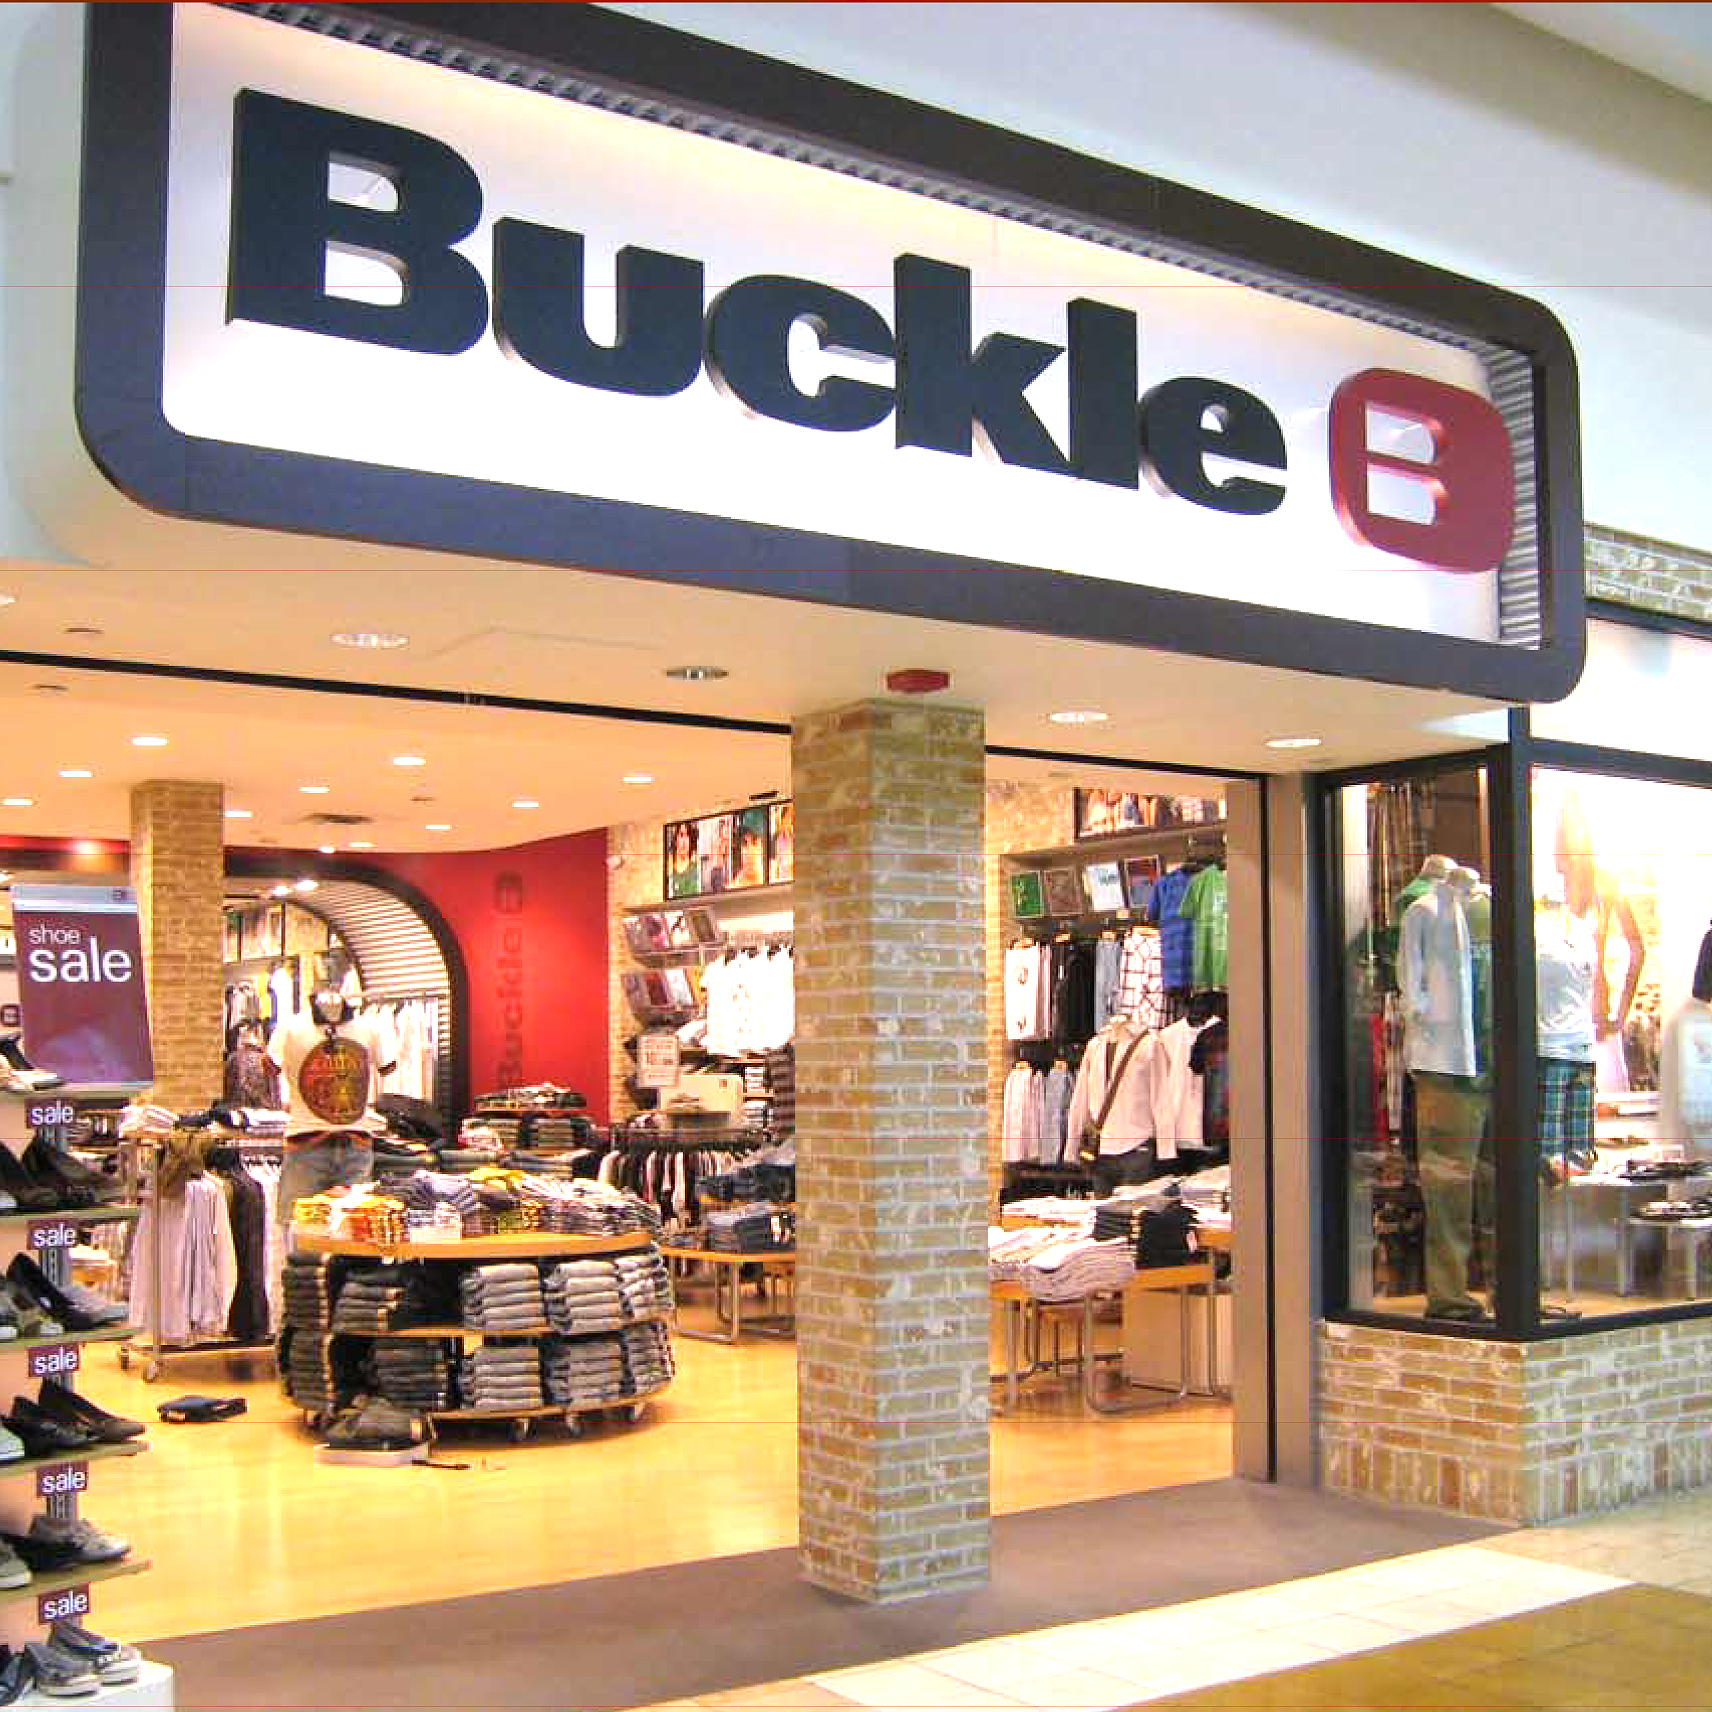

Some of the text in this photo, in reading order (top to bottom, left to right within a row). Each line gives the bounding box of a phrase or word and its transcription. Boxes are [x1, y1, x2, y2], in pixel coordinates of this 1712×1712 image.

[226, 88, 1288, 516] Buckle
[29, 924, 82, 945] shoe
[29, 936, 132, 983] sale
[31, 1099, 74, 1126] sale
[33, 1222, 76, 1247] sale
[33, 1346, 78, 1374] sale
[42, 1465, 86, 1493] sale
[43, 1590, 88, 1620] sale
